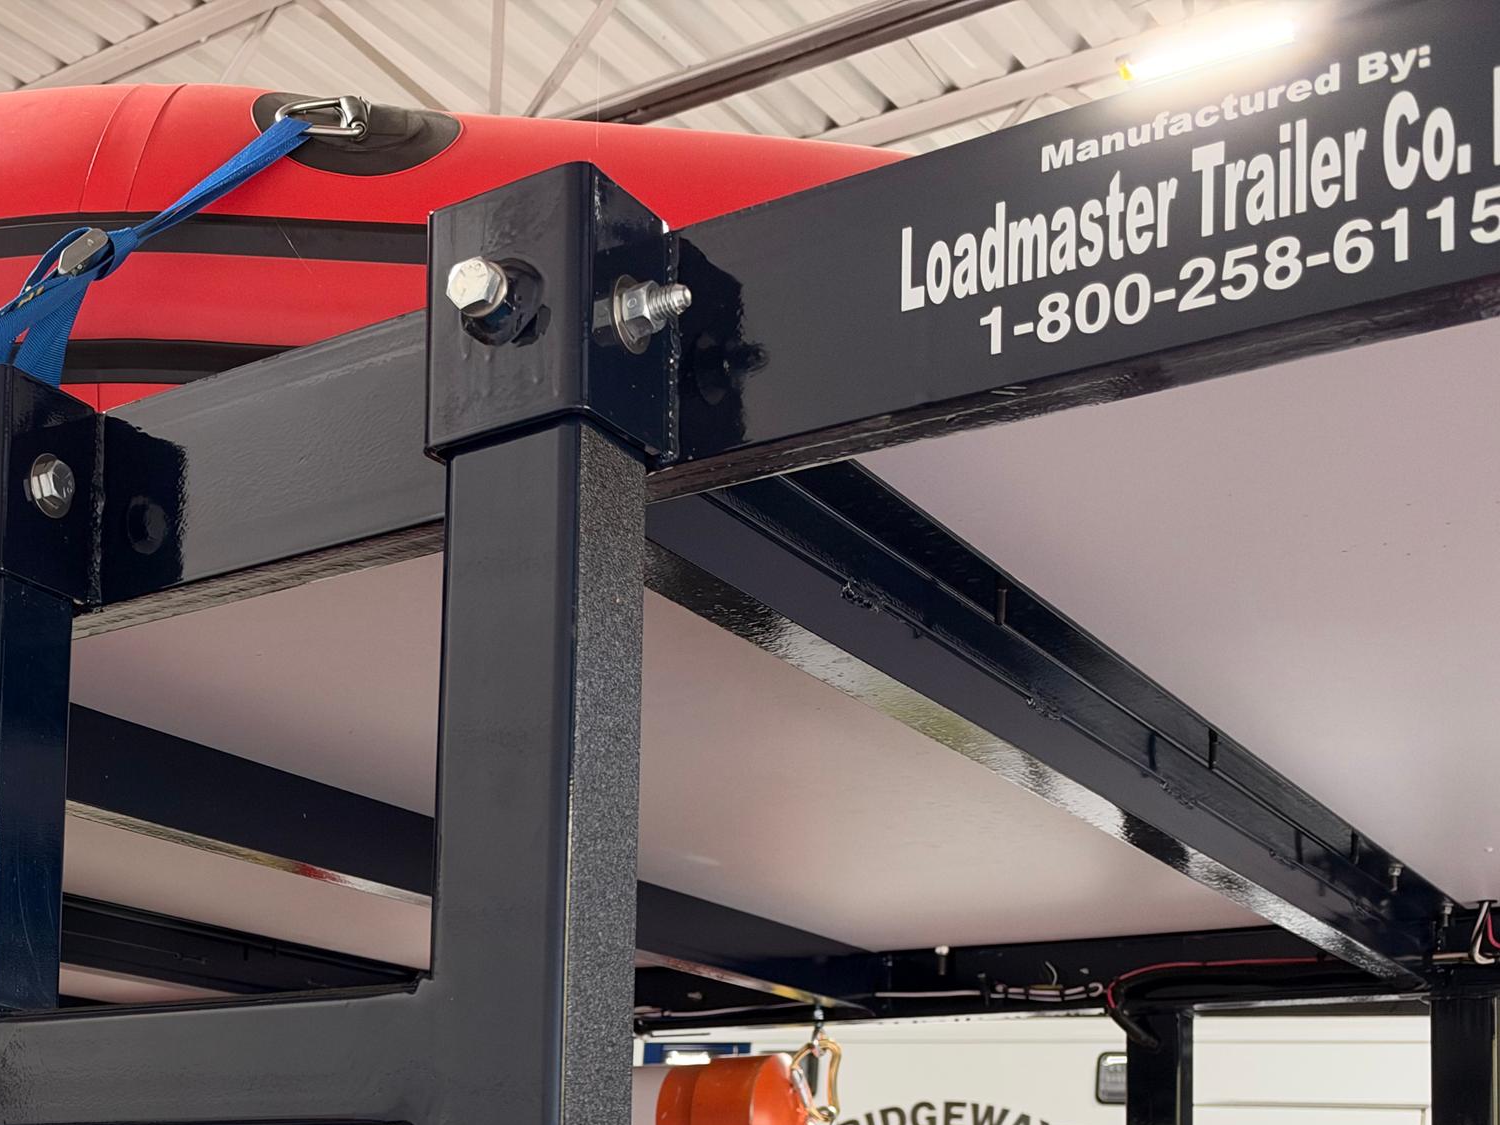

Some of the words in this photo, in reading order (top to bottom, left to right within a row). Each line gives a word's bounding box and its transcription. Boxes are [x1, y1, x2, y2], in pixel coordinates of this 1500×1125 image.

[1040, 62, 1341, 173] Manufactured
[1358, 44, 1432, 85] By:
[901, 170, 1179, 313] Loadmaster
[1191, 118, 1367, 237] Trailer
[1383, 90, 1472, 190] Co.
[979, 185, 1500, 355] 1-800-258-6115
